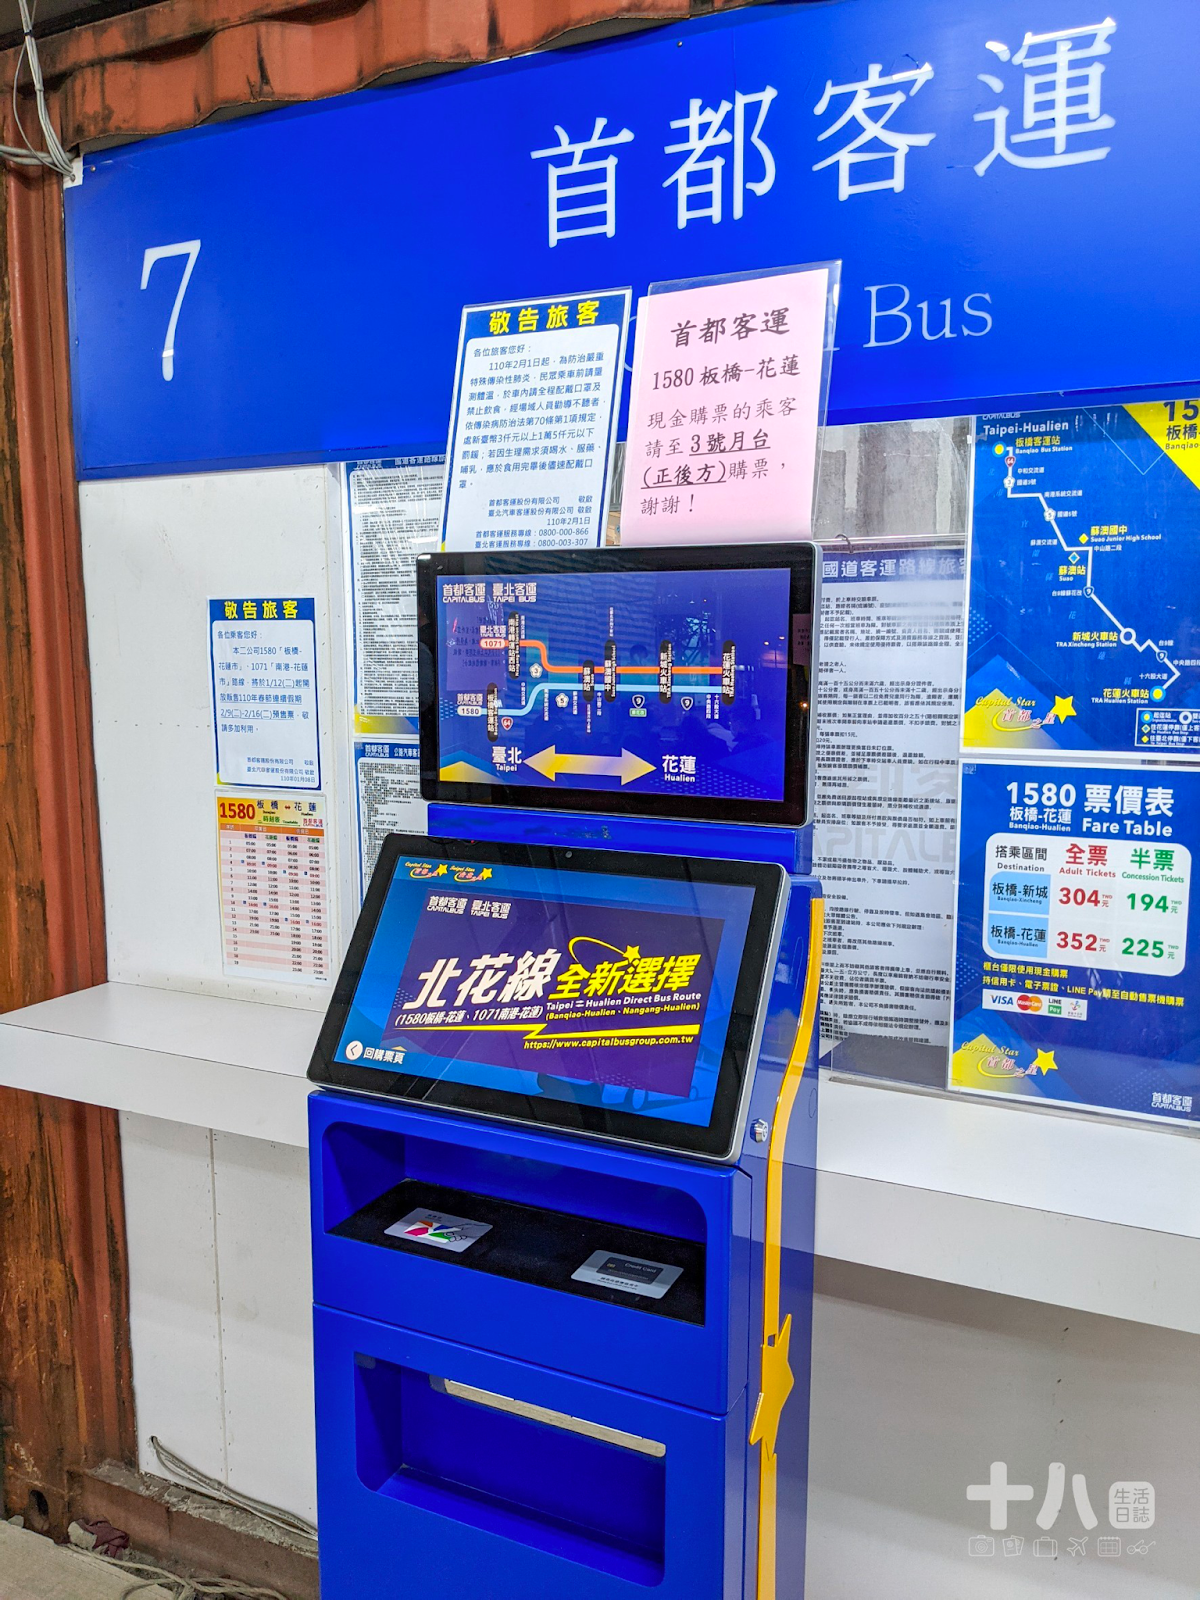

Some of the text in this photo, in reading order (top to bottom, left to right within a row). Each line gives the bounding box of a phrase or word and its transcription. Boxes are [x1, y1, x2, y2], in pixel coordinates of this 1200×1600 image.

[530, 17, 1117, 249] 首都客運
[140, 239, 202, 382] 7
[488, 300, 600, 335] 敬告旅客
[863, 283, 994, 349] Bus
[670, 307, 791, 348] 首都客運
[473, 344, 532, 358] 各位旅客您好：
[647, 397, 798, 430] 現金購票的乘客
[1163, 400, 1199, 422] 15
[983, 420, 1069, 437] Taipei-Hualien
[1015, 436, 1061, 448] 板橋客運站
[1015, 447, 1039, 455] Banqiao
[488, 496, 560, 507] 首都客運股份有限公司
[639, 493, 696, 517] 謝謝！
[546, 516, 590, 526] 110年2月1日
[1126, 535, 1140, 543] High
[442, 583, 486, 596] 首都客運
[492, 582, 537, 596] 臺北客運
[224, 600, 299, 620] 敬告旅客
[1072, 631, 1119, 642] 新城火車站
[1068, 641, 1095, 649] Xincheng
[722, 652, 730, 694] 花蓮火車站
[1103, 688, 1150, 699] 花蓮火車站
[975, 695, 1012, 709] Capital
[1014, 696, 1036, 707] Star
[492, 745, 522, 764] 臺北
[495, 763, 518, 772] Taipei
[662, 754, 697, 774] 花蓮
[664, 773, 695, 783] Hualien
[1006, 781, 1076, 807] 1580
[1084, 783, 1175, 818] 票價表
[219, 802, 256, 820] 1580
[294, 802, 317, 812] 花蓮
[1009, 806, 1072, 824] 板橋-花蓮
[1008, 822, 1071, 833] Banqiao-Hualien
[1082, 817, 1173, 837] Fare Table
[995, 844, 1048, 862] 搭乘區間
[1065, 843, 1108, 867] 全票
[1130, 847, 1175, 872] 半票
[997, 862, 1045, 873] Destination
[1059, 867, 1116, 878] Adult Tickets
[1121, 871, 1185, 884] Concession Tickets
[992, 882, 1049, 899] 板橋-新城
[1058, 887, 1101, 908] 304
[426, 906, 465, 914] CAPITALBUS
[429, 895, 468, 910] 首都客運
[472, 899, 511, 914] 臺北客運
[1101, 900, 1110, 908] 元
[1126, 893, 1169, 913] 194
[1170, 906, 1178, 914] 元
[470, 909, 490, 917] TAIPEI
[990, 925, 1047, 943] 板橋-花蓮
[1056, 931, 1098, 952] 352
[1099, 944, 1107, 952] 元
[1121, 937, 1165, 959] 225
[1167, 951, 1175, 960] 元
[548, 954, 701, 1000] 全新選擇
[983, 961, 1068, 979] 櫃台僅限使用現金購票
[402, 948, 562, 1010] 北花線
[546, 992, 702, 1011] Taipei Hualien Direct Bus Route
[990, 994, 1014, 1006] VISA
[1048, 997, 1062, 1005] LINE
[1049, 1006, 1061, 1014] Pay
[523, 1035, 694, 1050] https://www.capitalbusgroup.com.tw
[960, 1041, 1020, 1057] Capital Star
[363, 1047, 405, 1065] 回購票頁
[1151, 1091, 1193, 1108] 首都客運
[1151, 1102, 1192, 1113] CAPITALBUS
[642, 1265, 657, 1273] Card
